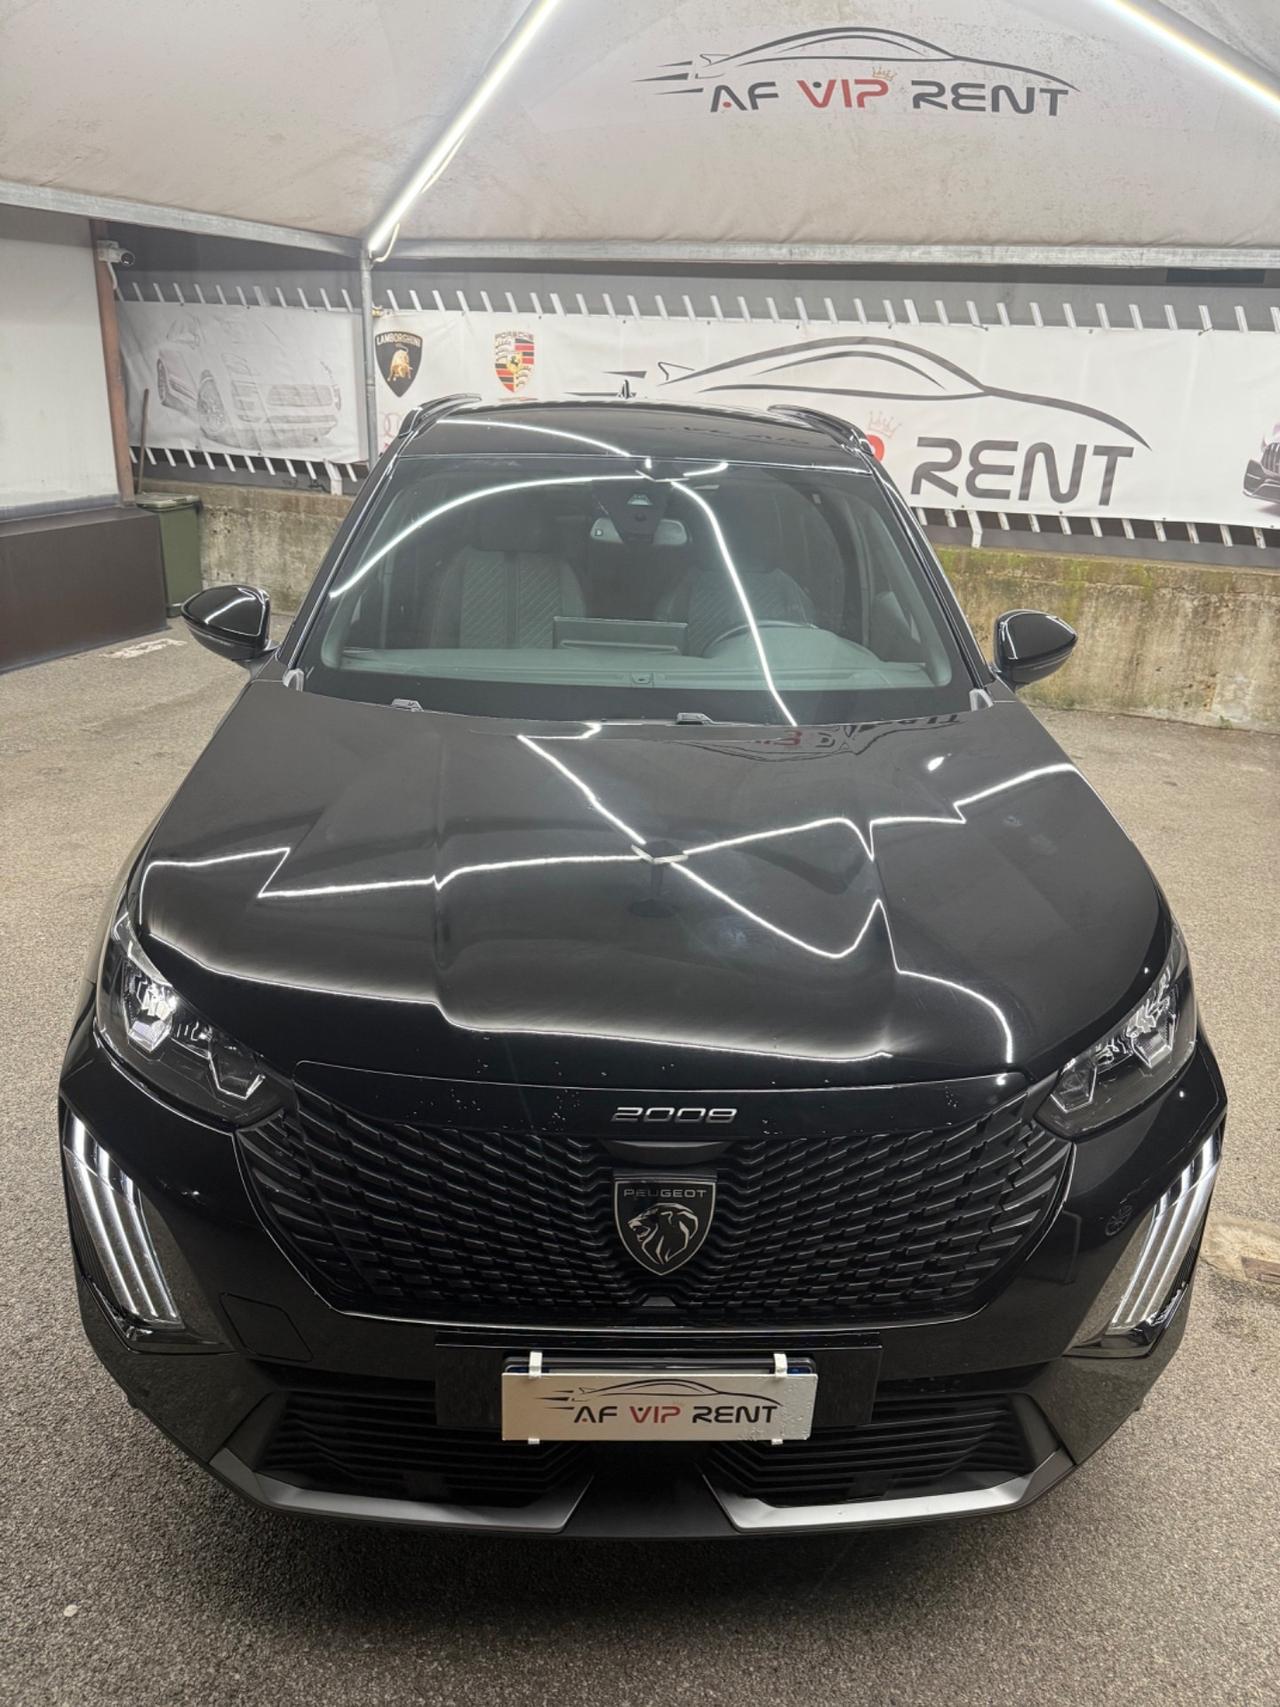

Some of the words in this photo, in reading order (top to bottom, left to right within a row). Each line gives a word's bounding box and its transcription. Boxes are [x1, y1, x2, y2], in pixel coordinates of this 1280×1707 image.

[710, 81, 779, 112] AF
[796, 79, 889, 109] VIP
[911, 80, 1068, 117] RENT
[911, 437, 1134, 506] RENT
[611, 1106, 738, 1123] 2008
[623, 1188, 707, 1198] PEUGEOT
[574, 1406, 617, 1424] AF
[629, 1406, 681, 1424] VIP
[692, 1406, 777, 1424] RENT
